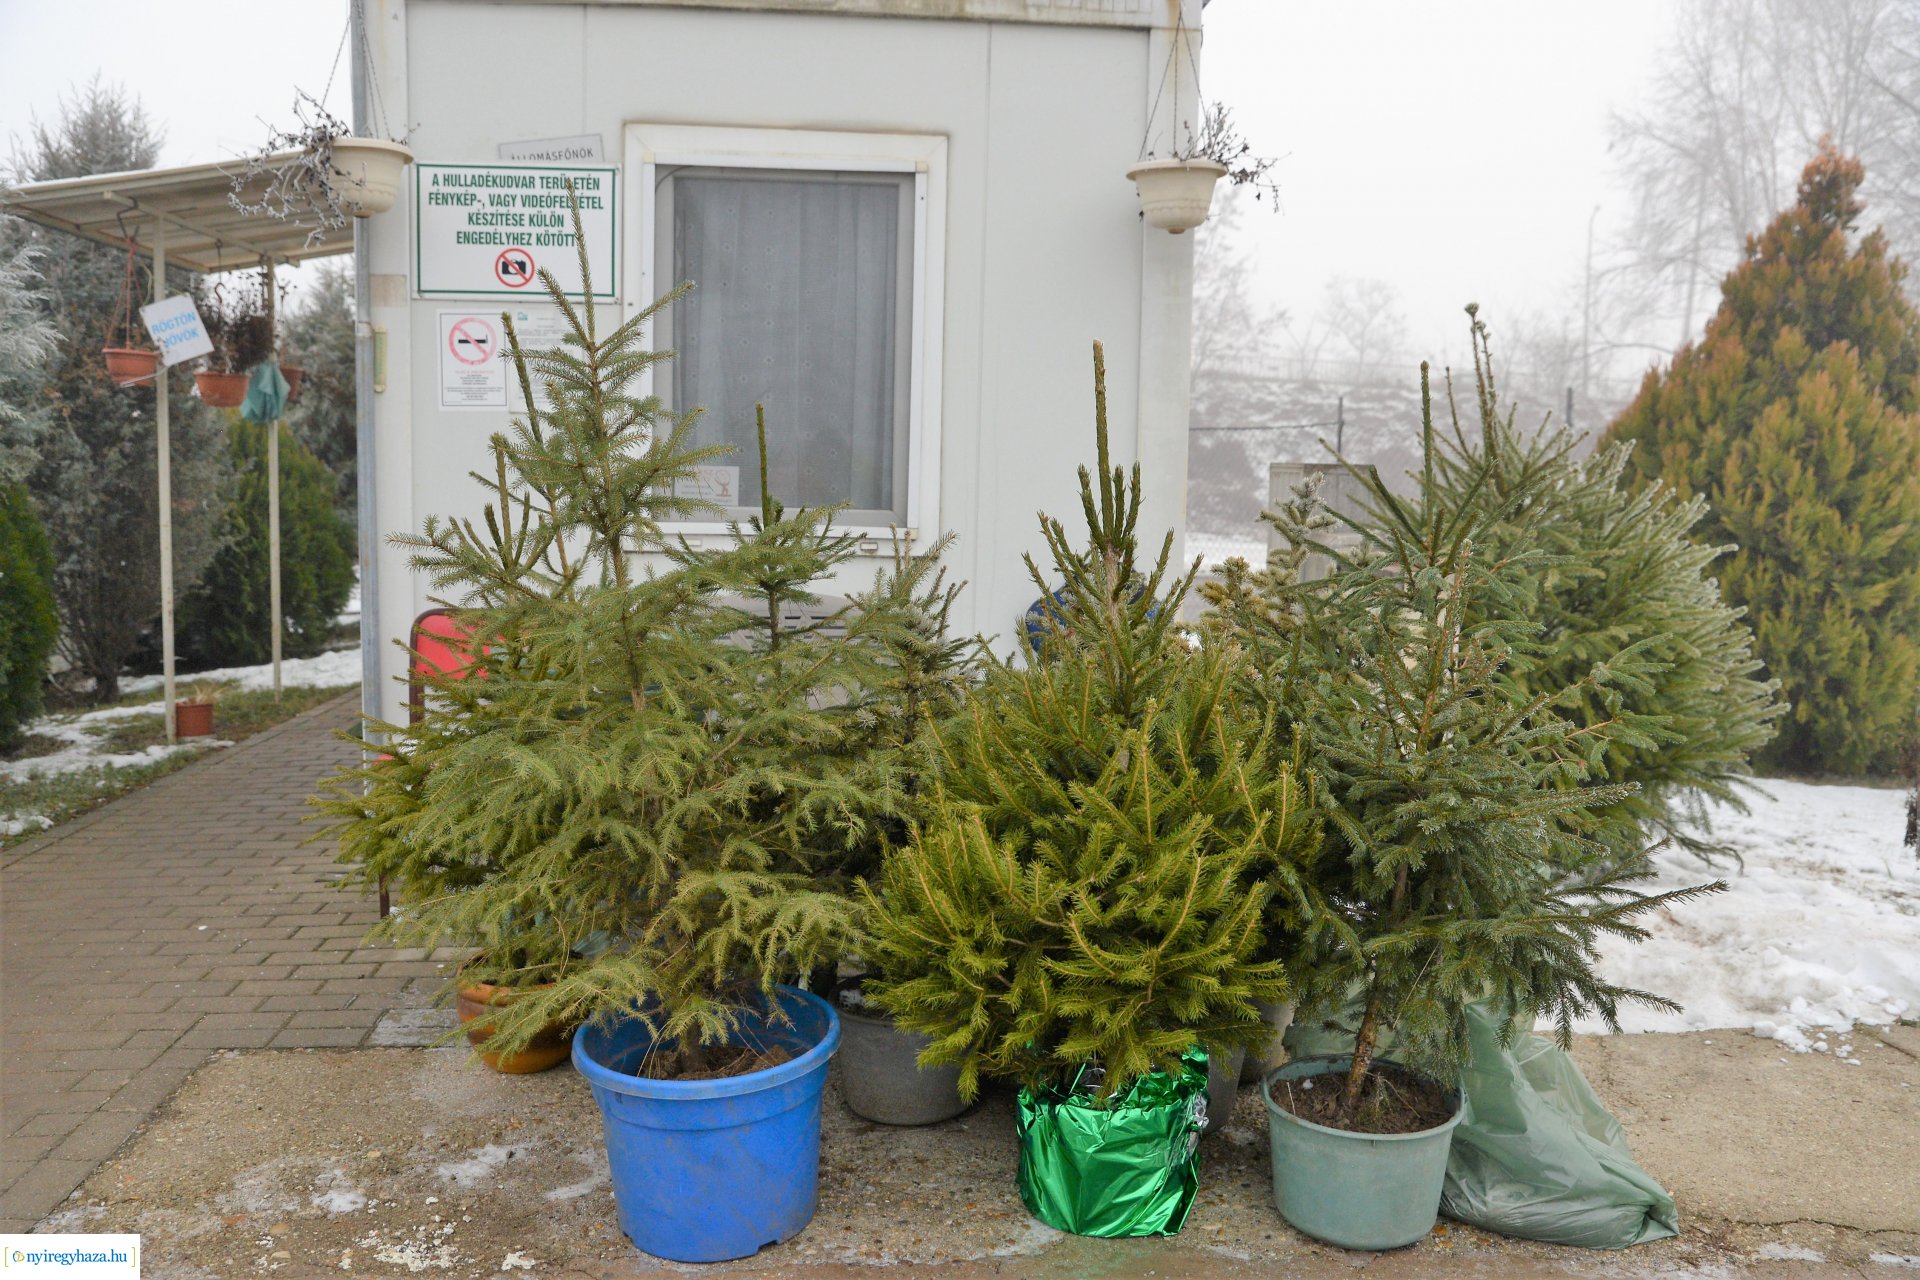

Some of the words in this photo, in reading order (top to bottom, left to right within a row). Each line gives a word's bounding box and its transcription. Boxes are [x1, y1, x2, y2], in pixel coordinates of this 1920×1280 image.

[432, 173, 440, 187] A
[443, 171, 535, 189] HULLADÉKUDVAR
[540, 173, 601, 191] TERÜETÉN
[428, 188, 485, 209] FÉNYKÉP-,
[489, 193, 516, 208] VAGY
[521, 191, 604, 210] VIDEÓFELÉTEL
[468, 209, 525, 227] KÉSZÍTÉSE
[529, 210, 564, 228] KÜLÖN
[456, 228, 532, 246] ENGEDÉLYHEZ
